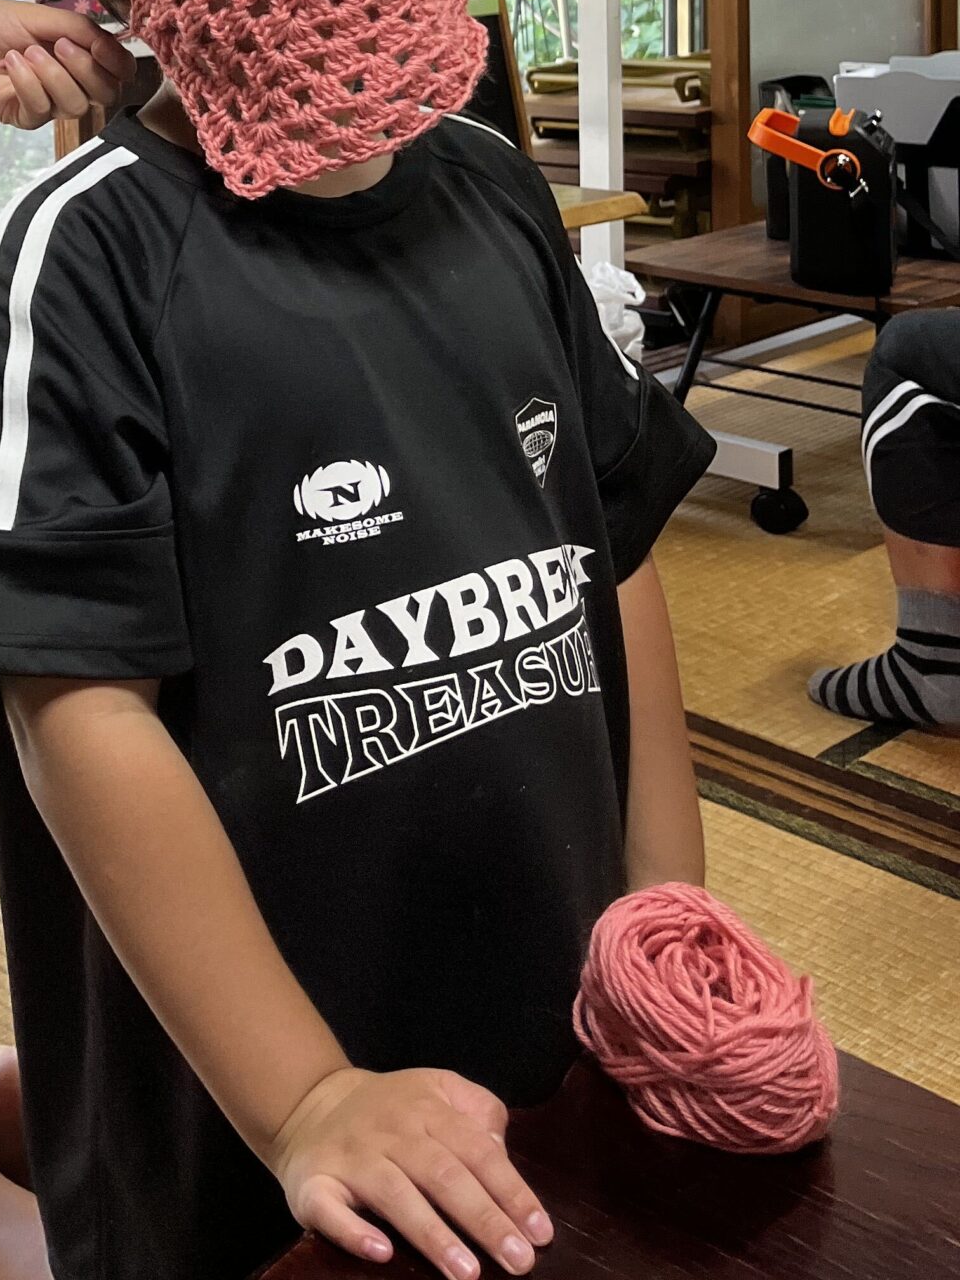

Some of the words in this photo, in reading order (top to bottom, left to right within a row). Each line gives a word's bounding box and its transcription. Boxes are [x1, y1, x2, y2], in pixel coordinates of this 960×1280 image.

[318, 482, 361, 508] N
[296, 511, 404, 543] MAKESOME
[321, 526, 381, 546] NOISE
